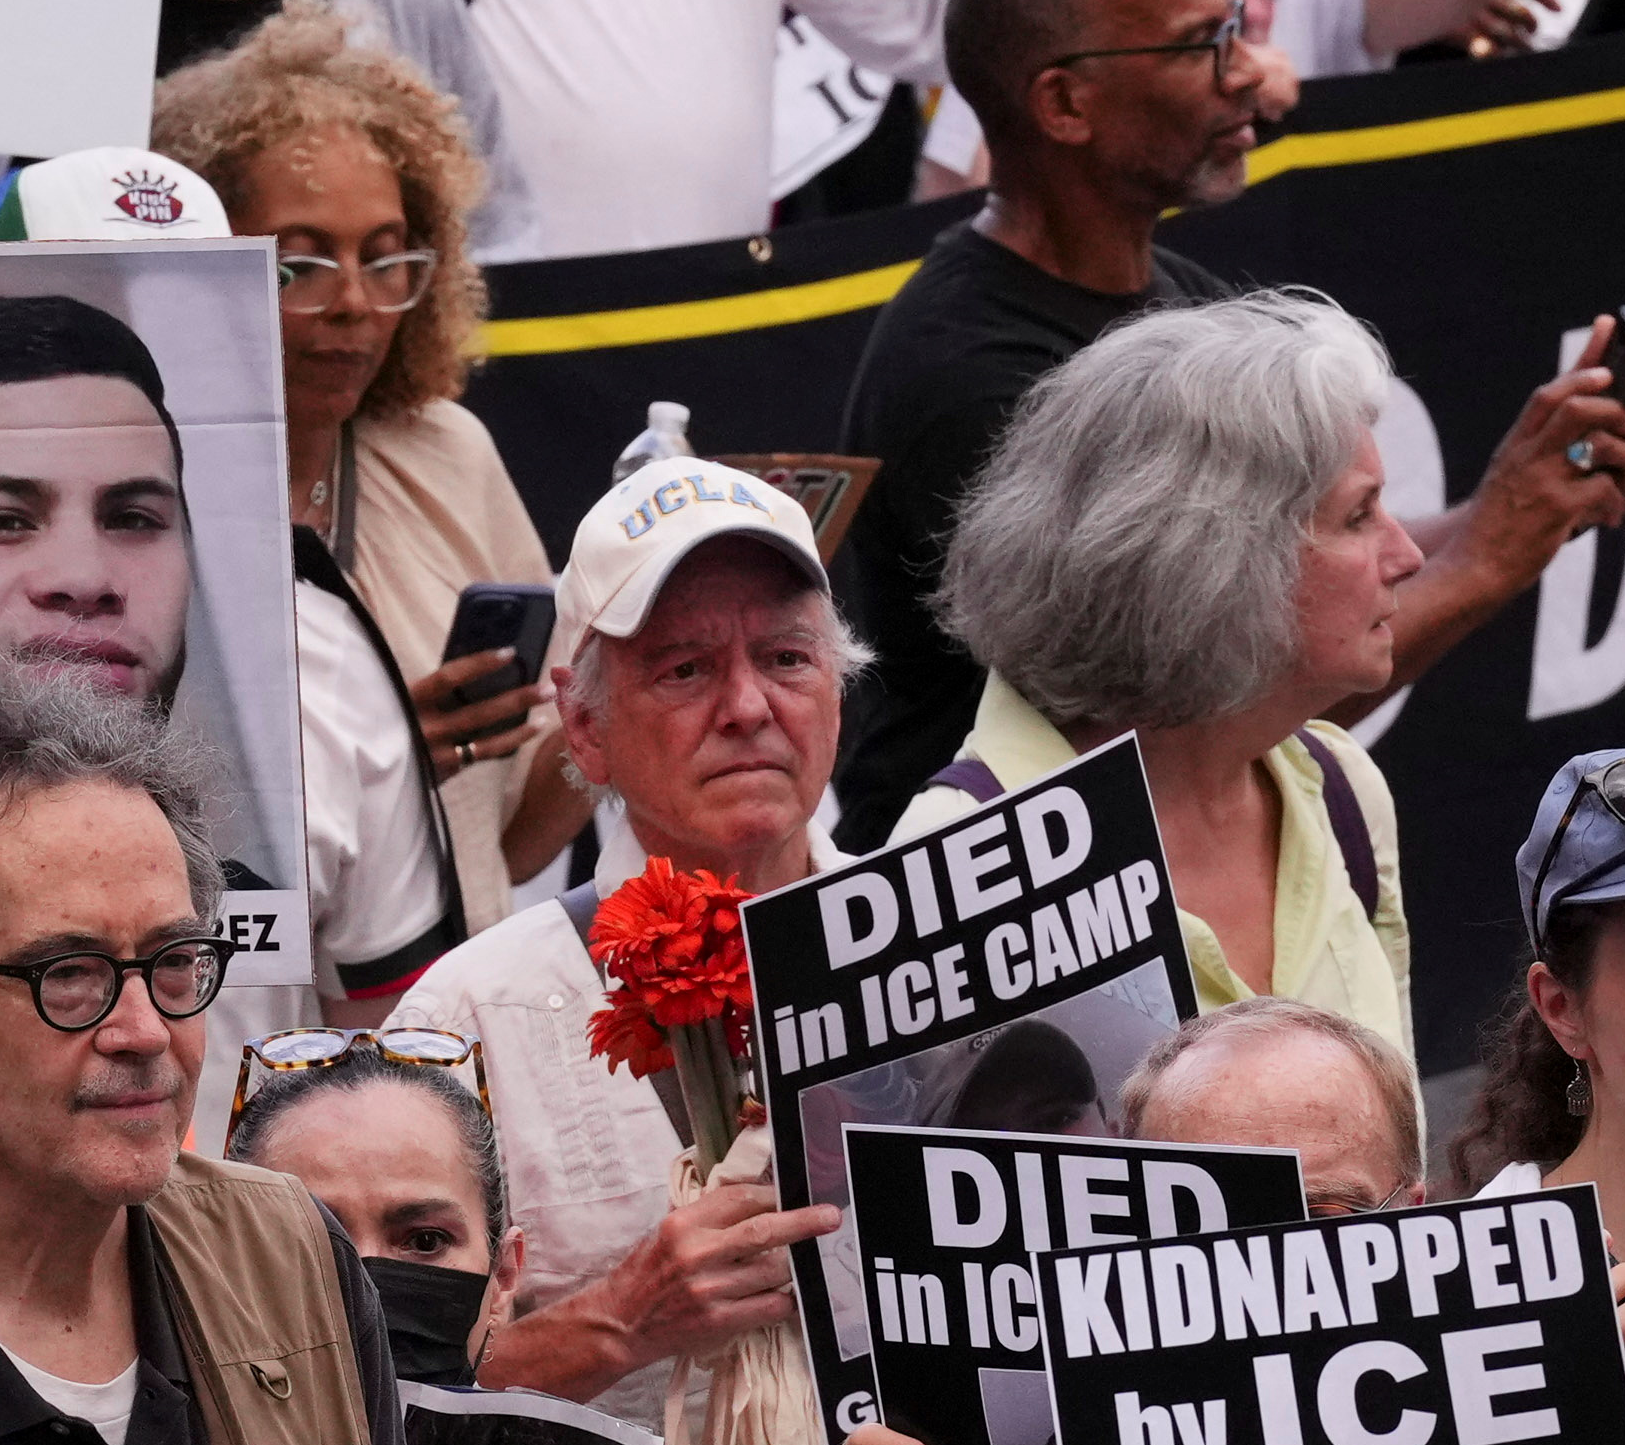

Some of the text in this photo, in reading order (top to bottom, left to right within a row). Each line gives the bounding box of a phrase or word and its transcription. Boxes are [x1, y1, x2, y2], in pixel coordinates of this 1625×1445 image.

[616, 474, 771, 542] UCLA
[816, 784, 1095, 973] DIED
[772, 857, 1162, 1077] in ICE CAMP
[922, 1146, 1228, 1253] DIED
[873, 1256, 1040, 1353] in IC
[1054, 1198, 1586, 1360] KIDNAPPED
